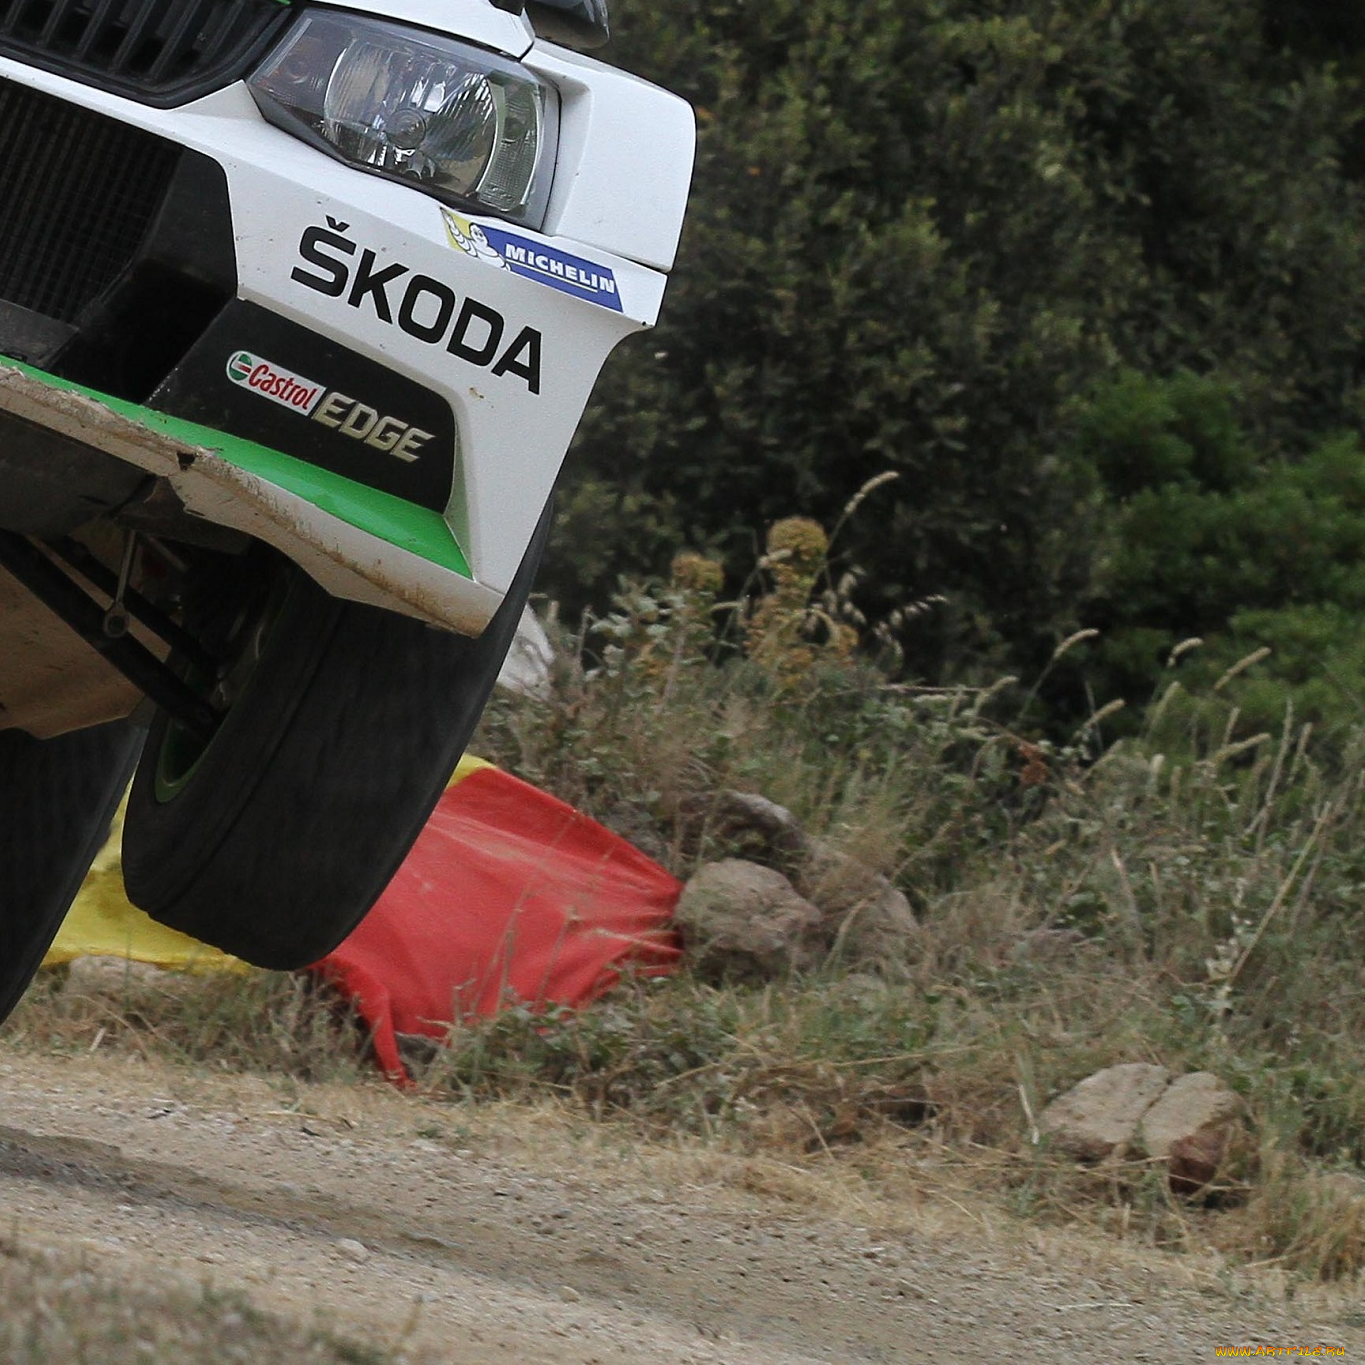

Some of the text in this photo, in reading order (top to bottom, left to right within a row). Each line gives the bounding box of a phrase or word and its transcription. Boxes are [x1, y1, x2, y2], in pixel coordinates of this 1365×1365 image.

[290, 215, 542, 395] ŠKODA
[505, 243, 616, 294] MICHELIN
[249, 363, 436, 463] Castrol EDGE
